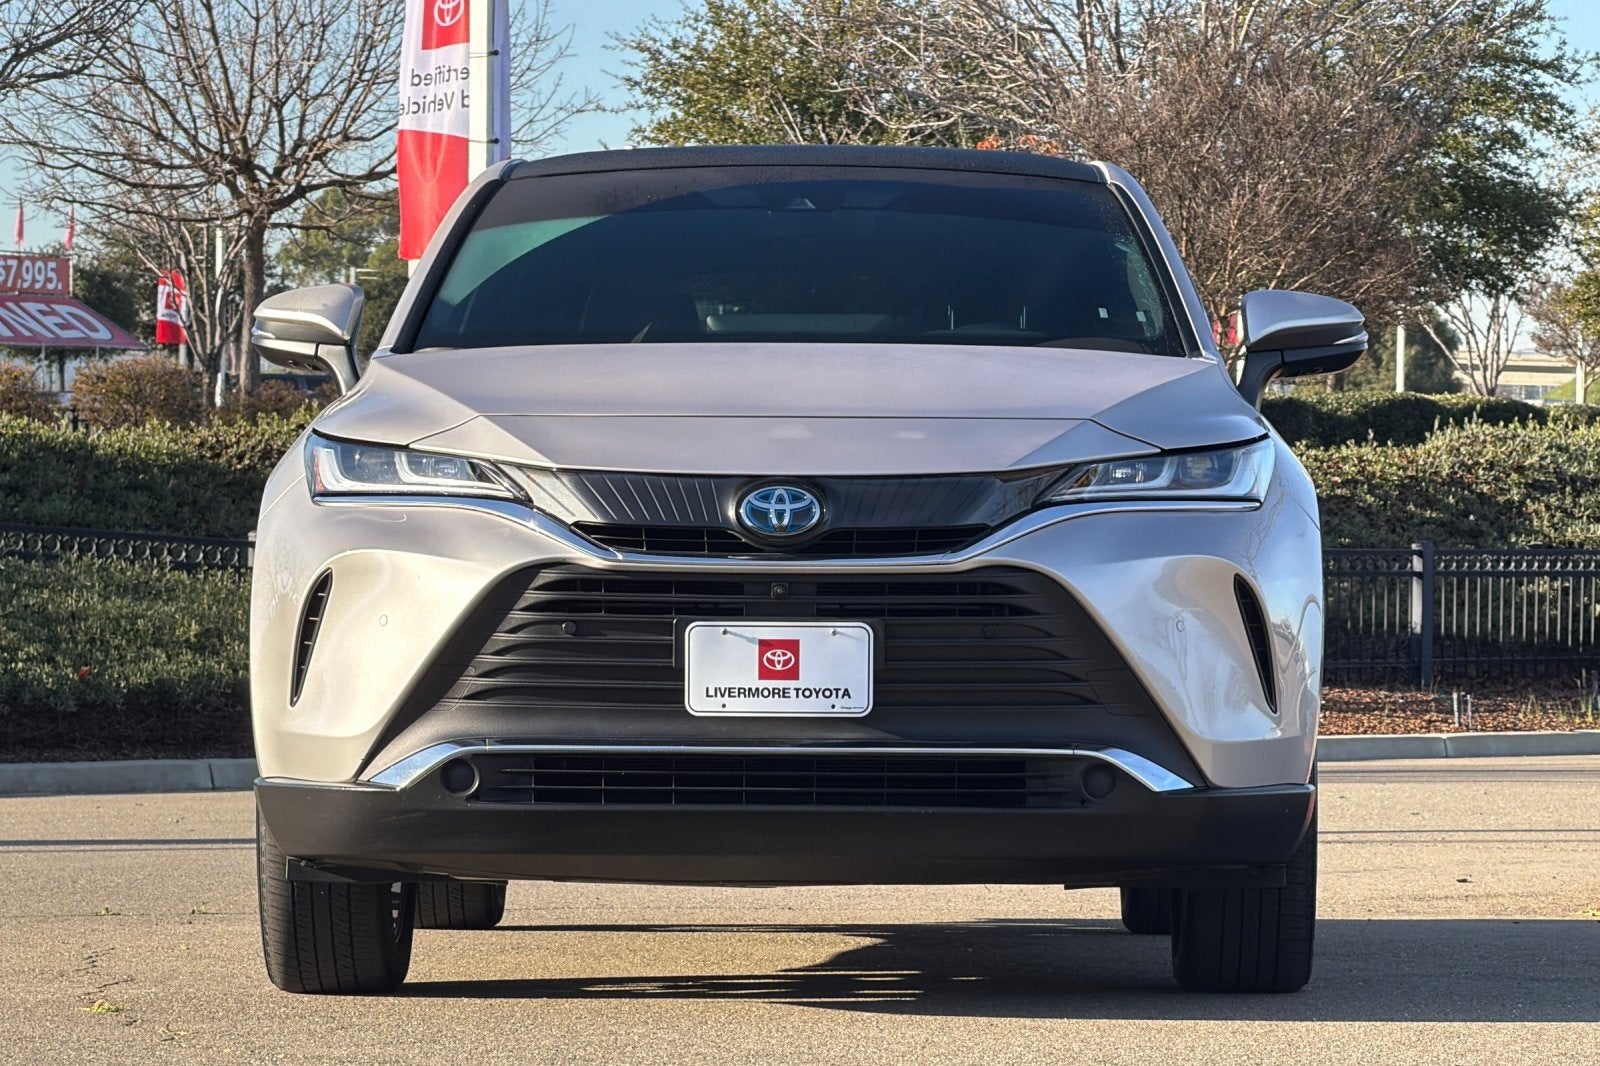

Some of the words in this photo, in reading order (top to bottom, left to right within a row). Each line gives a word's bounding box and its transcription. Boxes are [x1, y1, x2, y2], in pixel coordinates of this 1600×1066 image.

[0, 302, 113, 340] NED
[705, 687, 790, 699] LIVERMORE
[794, 687, 852, 699] TOYOTA
